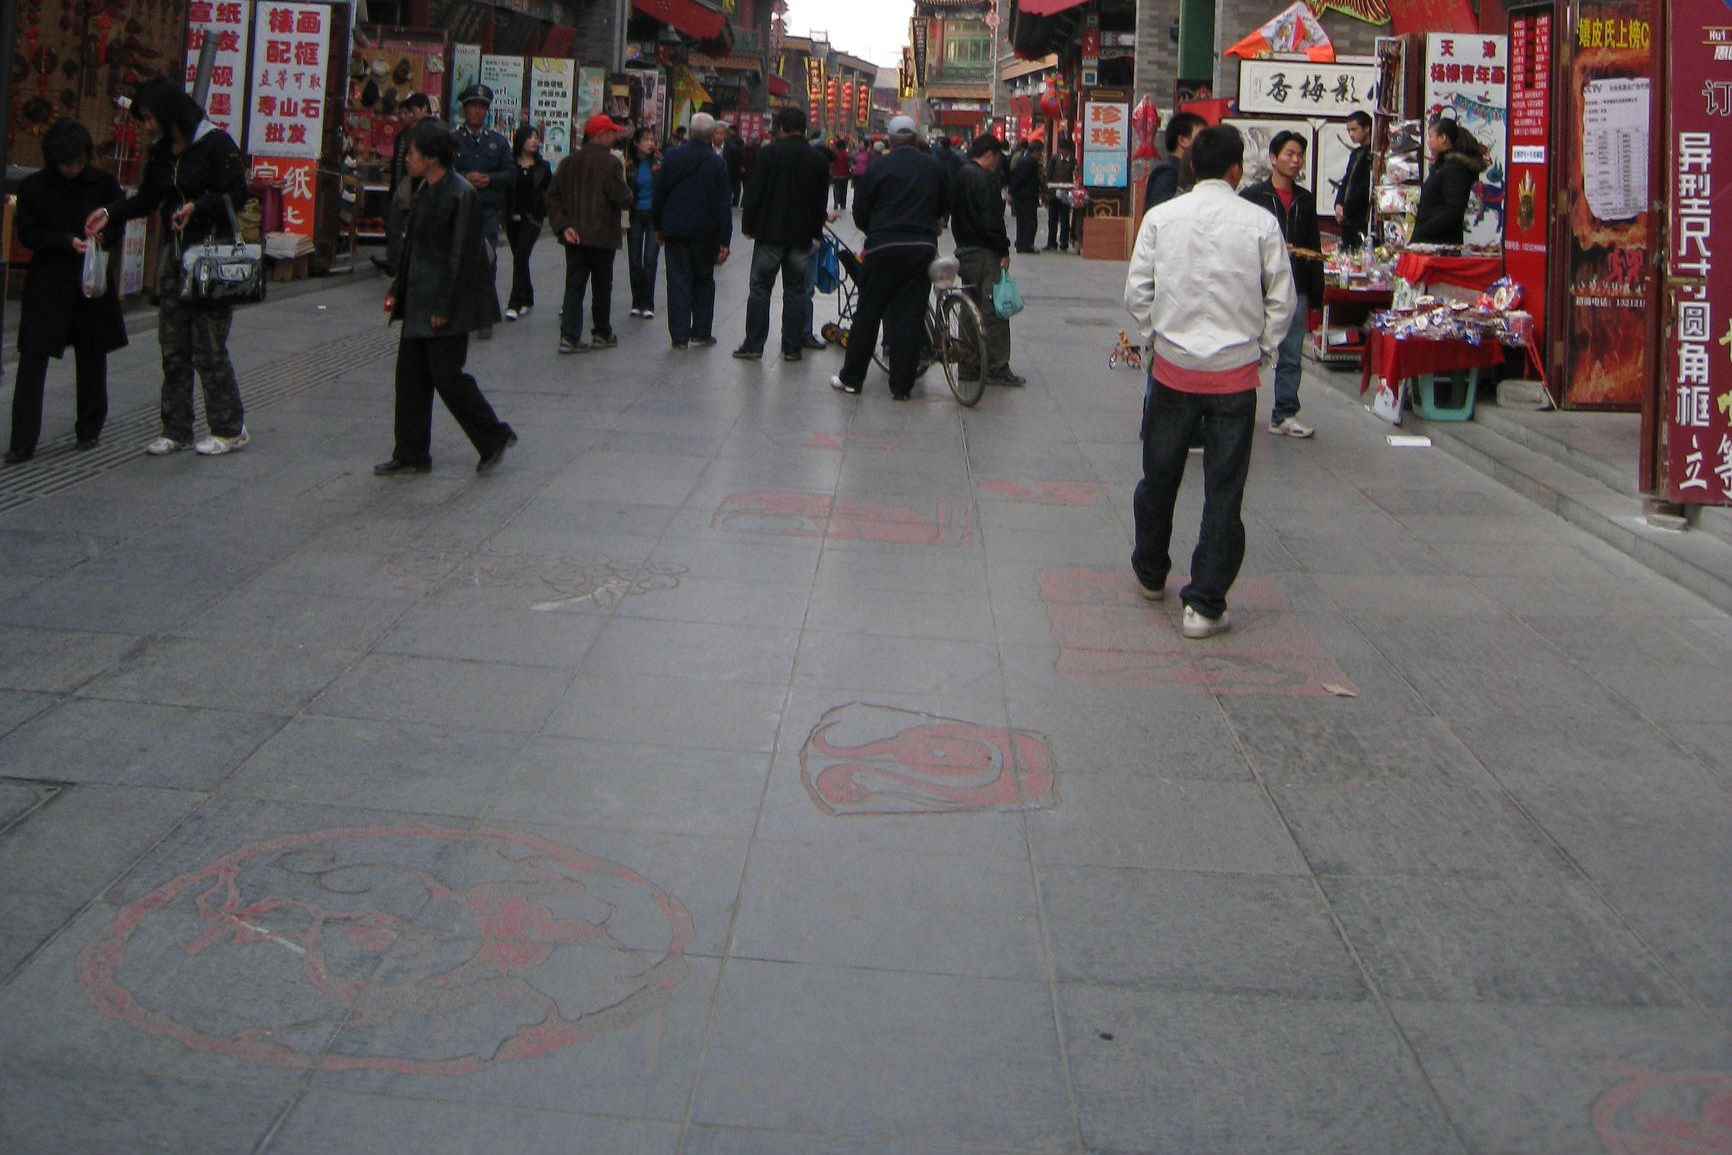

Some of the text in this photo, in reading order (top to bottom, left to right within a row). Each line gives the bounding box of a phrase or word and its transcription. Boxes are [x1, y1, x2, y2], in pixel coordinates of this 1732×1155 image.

[190, 0, 242, 25] 宣纸
[268, 7, 321, 34] 裱画
[266, 40, 320, 66] 配框
[258, 69, 322, 91] 立等可取
[257, 94, 321, 118] 寿山石
[265, 122, 307, 145] 批发
[1090, 106, 1121, 147] 珍珠
